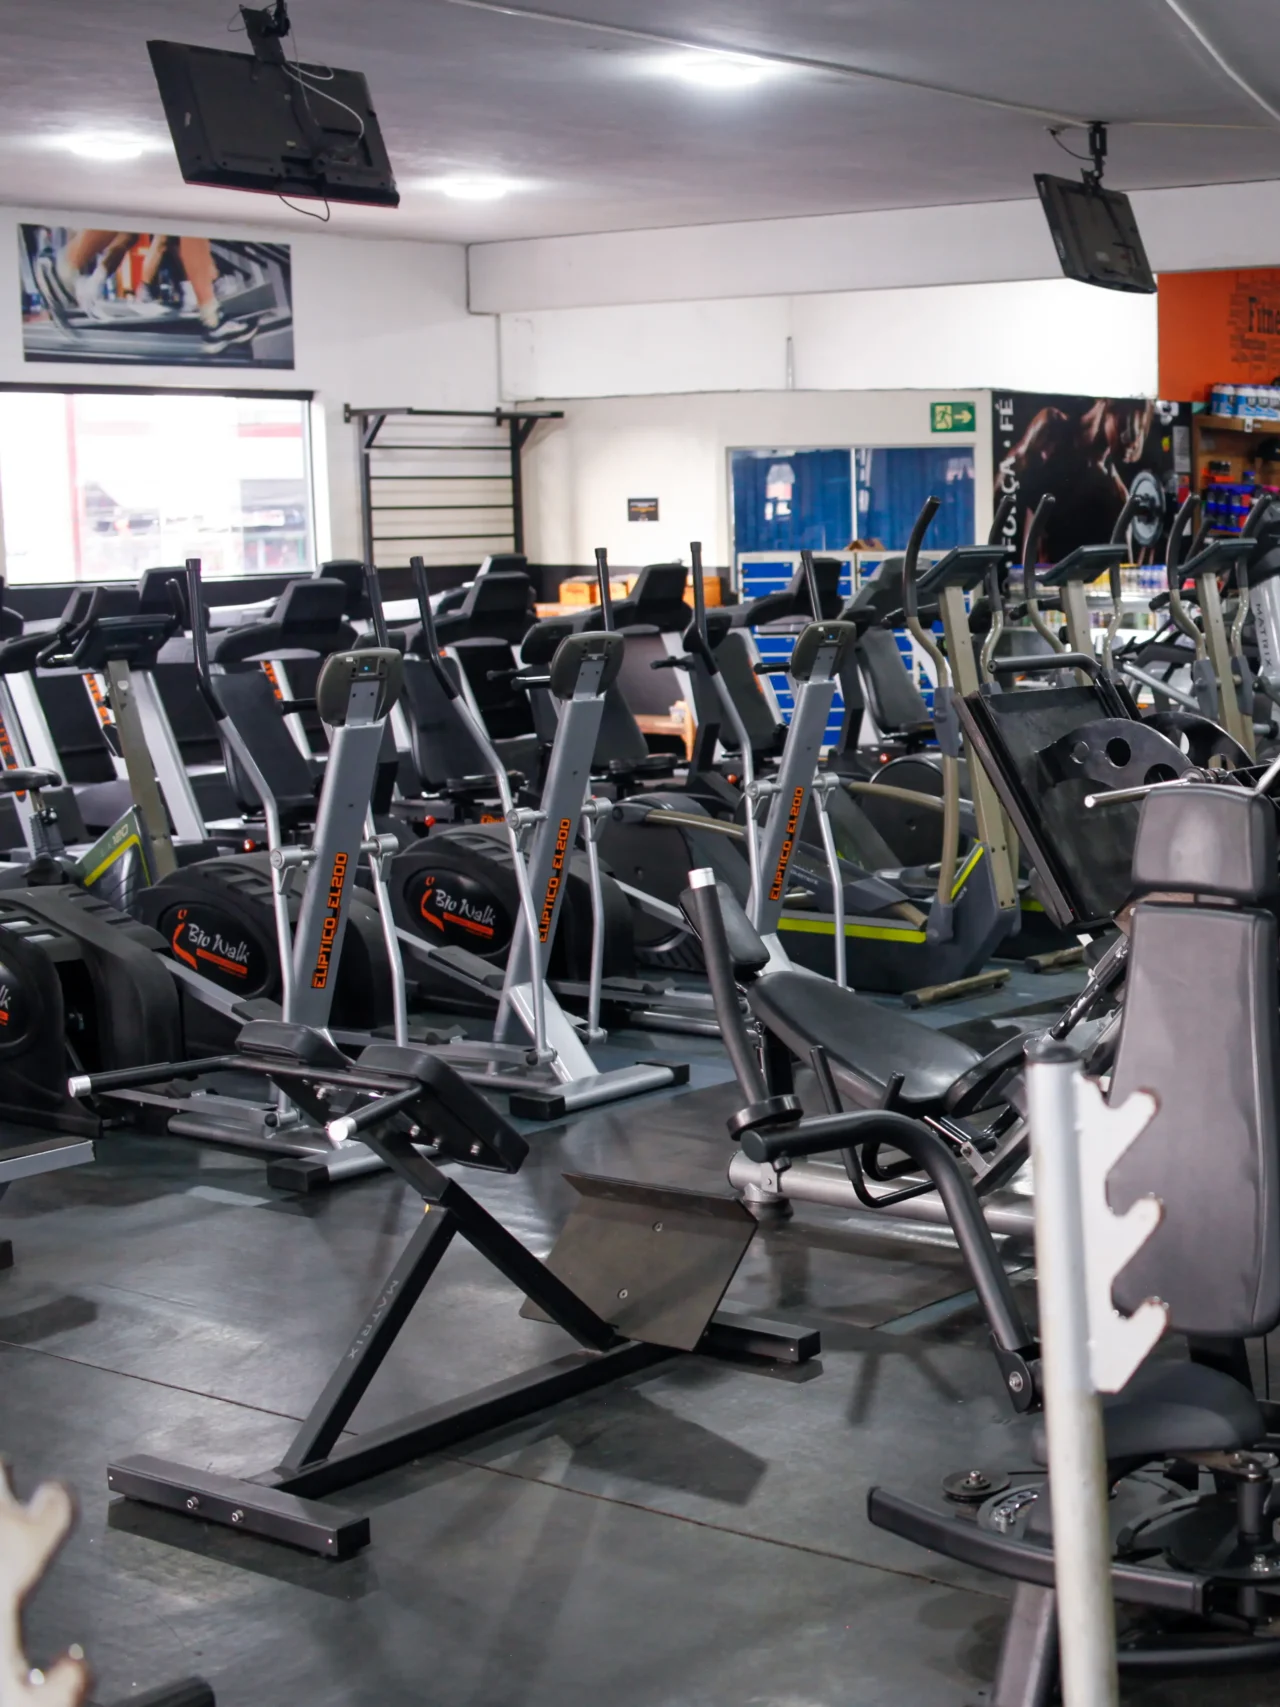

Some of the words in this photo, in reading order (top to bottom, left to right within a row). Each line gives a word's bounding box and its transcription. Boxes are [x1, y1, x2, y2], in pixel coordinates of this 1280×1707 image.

[995, 399, 1013, 431] FÉ
[1000, 456, 1020, 552] FOÇA
[1255, 603, 1272, 667] MATRIX
[540, 877, 559, 942] ELIPTICO
[552, 818, 571, 869] EL200
[769, 840, 792, 900] ELIPTICO
[786, 786, 804, 833] EL200
[188, 923, 210, 947] Bio
[212, 934, 249, 963] Walk
[312, 917, 337, 988] ELIPTICO
[327, 852, 348, 908] EL200
[436, 889, 457, 911] Bio
[458, 899, 496, 926] Walk
[348, 1279, 399, 1359] MATRIX
